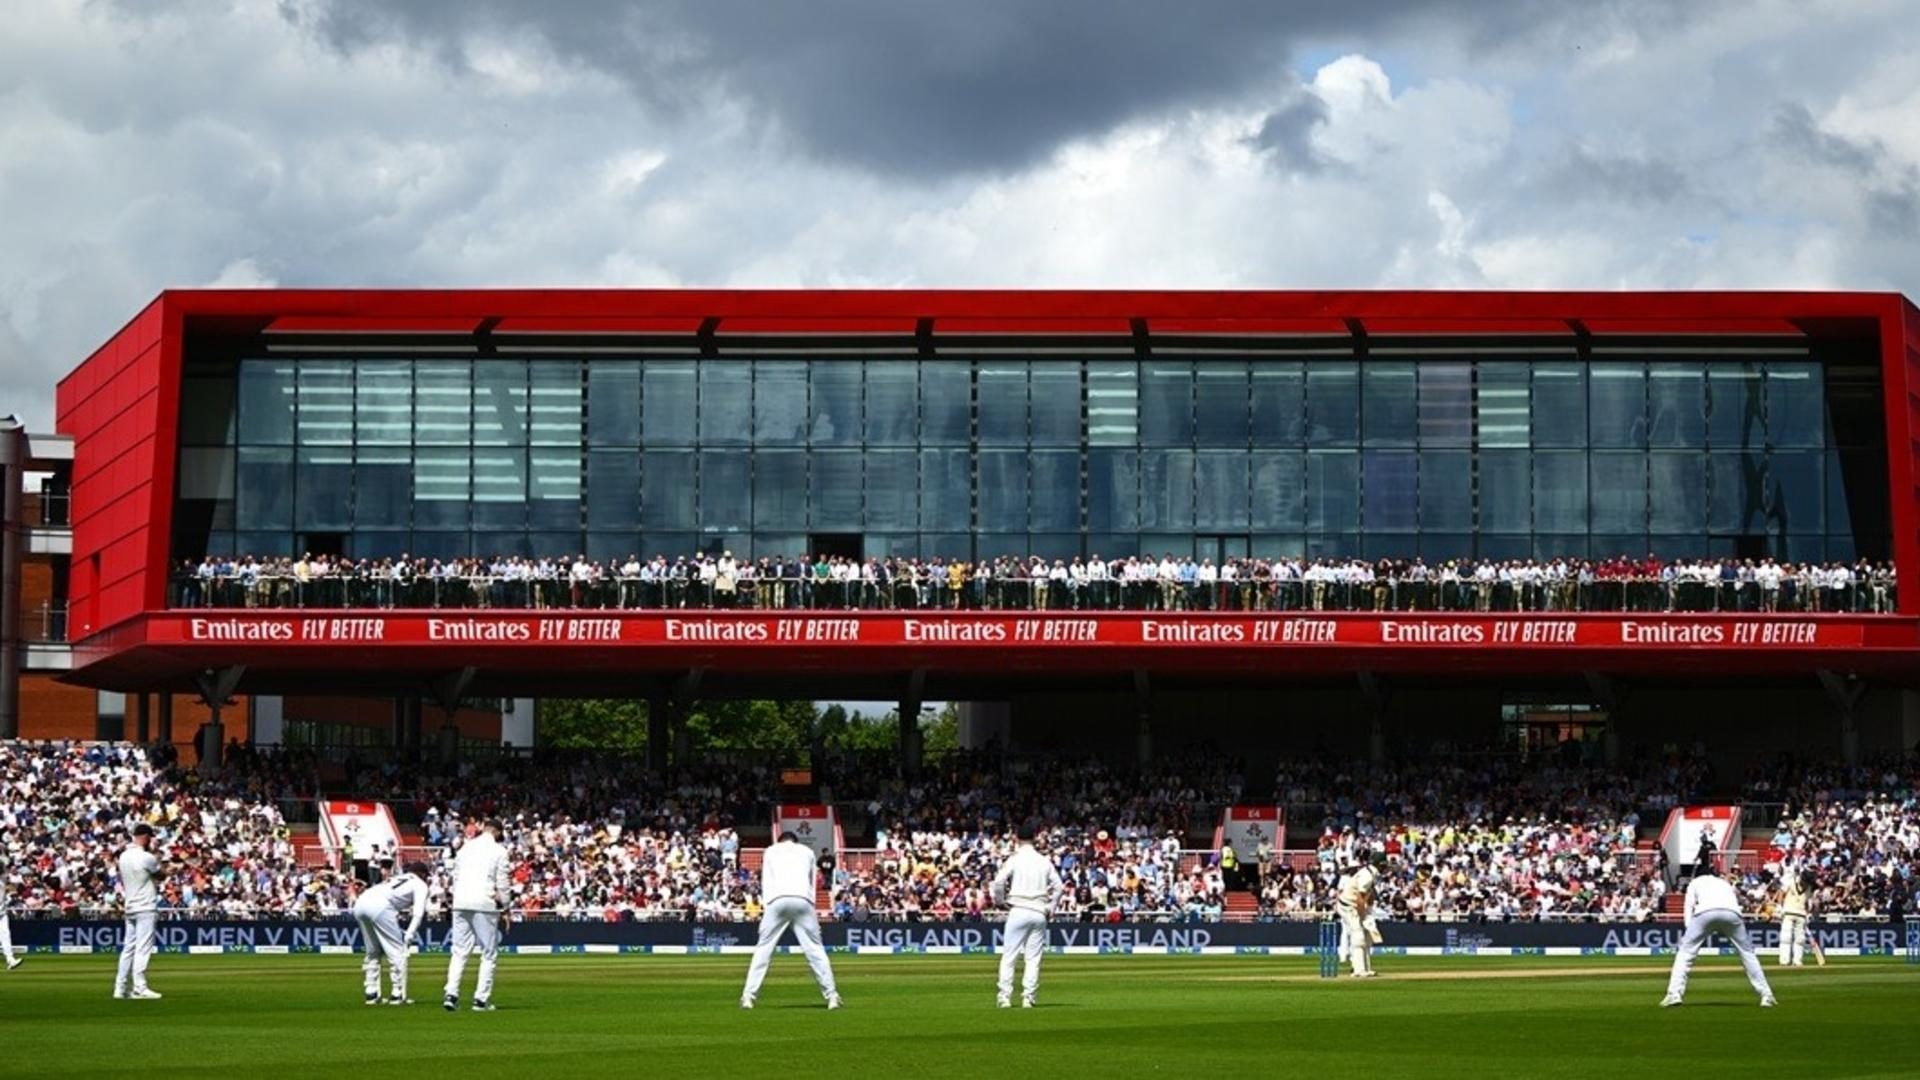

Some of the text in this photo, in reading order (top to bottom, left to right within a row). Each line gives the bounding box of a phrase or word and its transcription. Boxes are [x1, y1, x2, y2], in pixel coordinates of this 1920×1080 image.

[191, 619, 385, 640] Emirates FLY BETTER
[427, 619, 622, 640] Emirates FLY BETTER
[665, 619, 860, 640] Emirates FLY BETTER
[903, 620, 1098, 640] Emirates FLY BETTER
[1141, 620, 1337, 641] Emirates FLY BETTER
[1380, 621, 1577, 642] Emirates FLY BETTER
[1621, 622, 1817, 643] Emirates FLY BETTER
[59, 927, 360, 946] ENGLND MEN V NEW
[847, 928, 982, 946] ENGLAND
[1060, 928, 1080, 946] V
[1089, 928, 1212, 947] IRELAND
